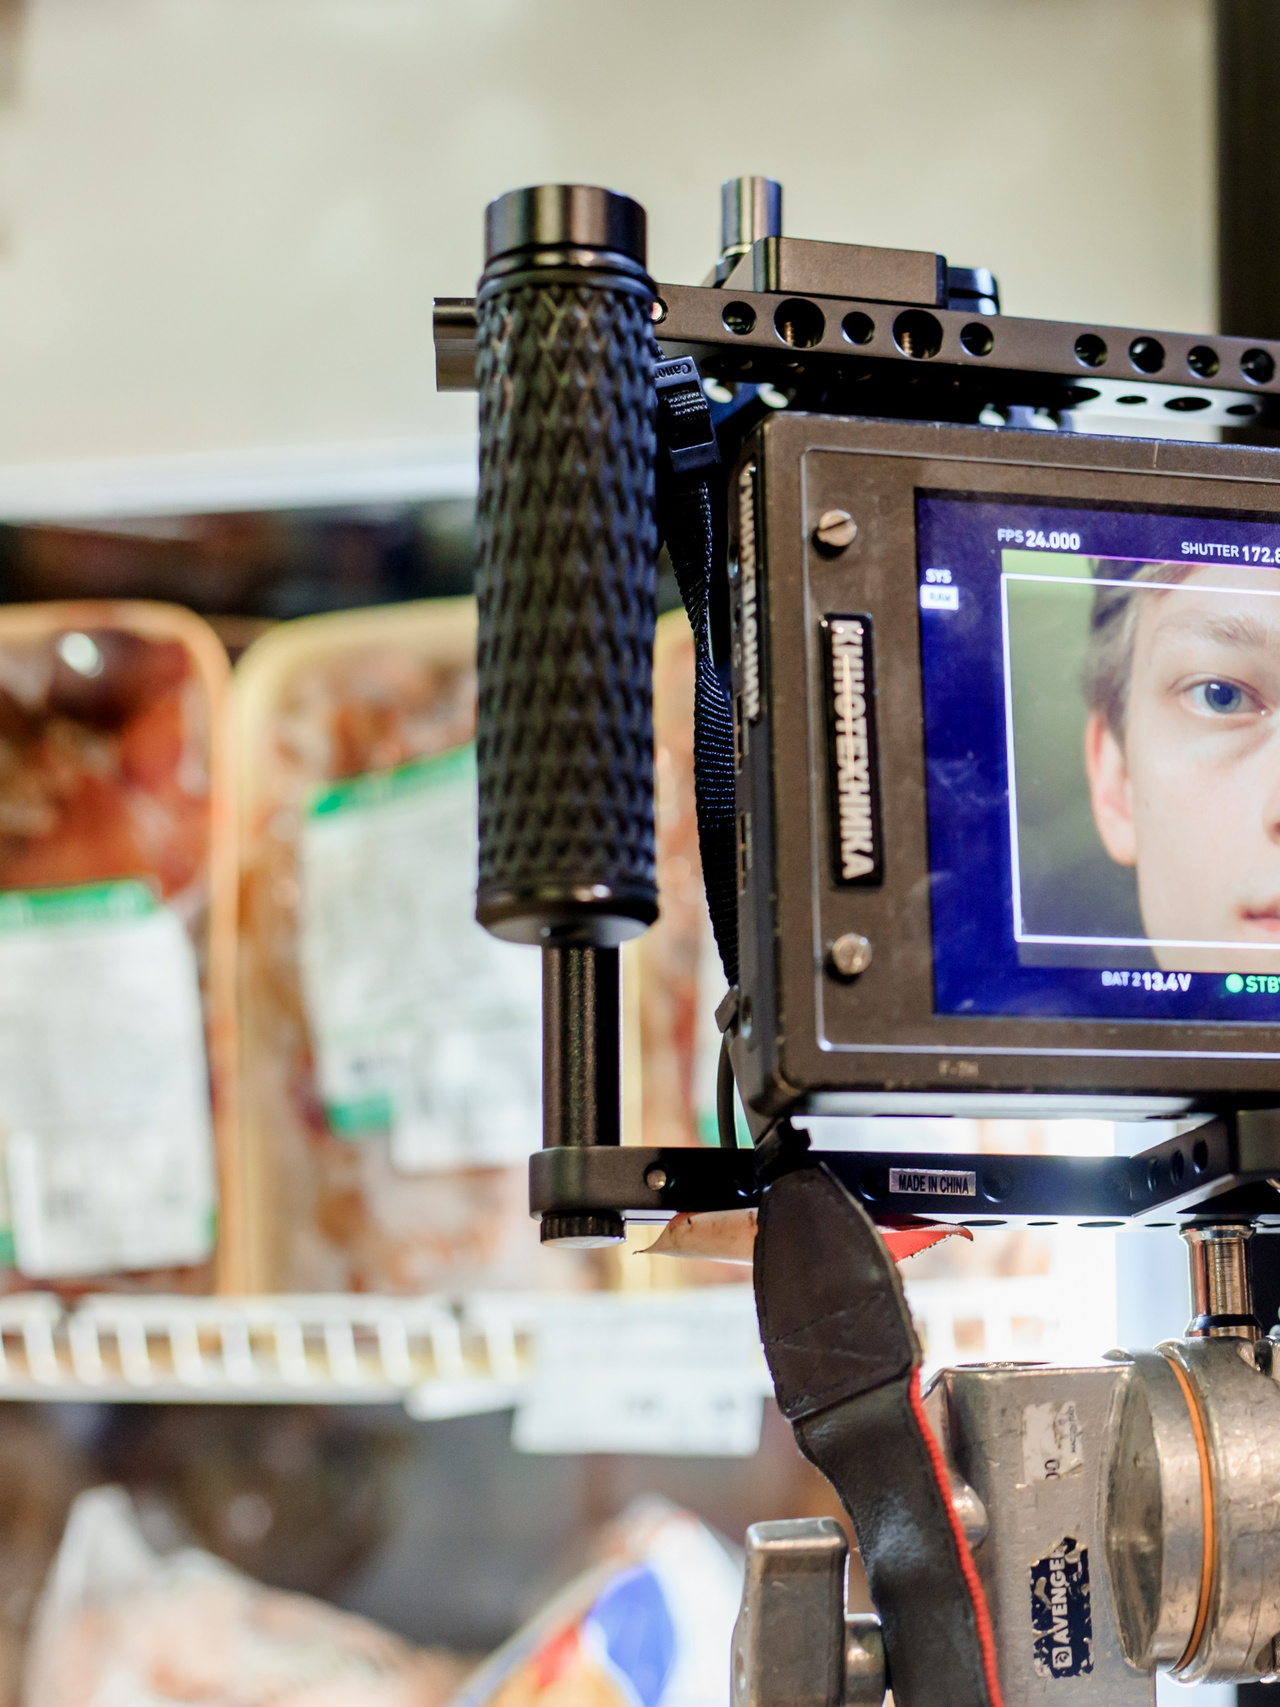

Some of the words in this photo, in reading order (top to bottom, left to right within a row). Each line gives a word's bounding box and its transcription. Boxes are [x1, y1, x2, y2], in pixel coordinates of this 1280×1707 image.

[997, 528, 1025, 544] FPS
[1025, 530, 1080, 550] 24.000
[1181, 541, 1239, 558] SHUTTER
[926, 567, 952, 584] SYS
[831, 620, 874, 880] КИНОТЕХНИКА
[1101, 970, 1130, 986] BAT
[1131, 971, 1141, 987] 2
[1142, 971, 1192, 992] 13.4V
[899, 1174, 925, 1192] MADE
[928, 1175, 937, 1192] IN
[940, 1176, 969, 1194] CHINA
